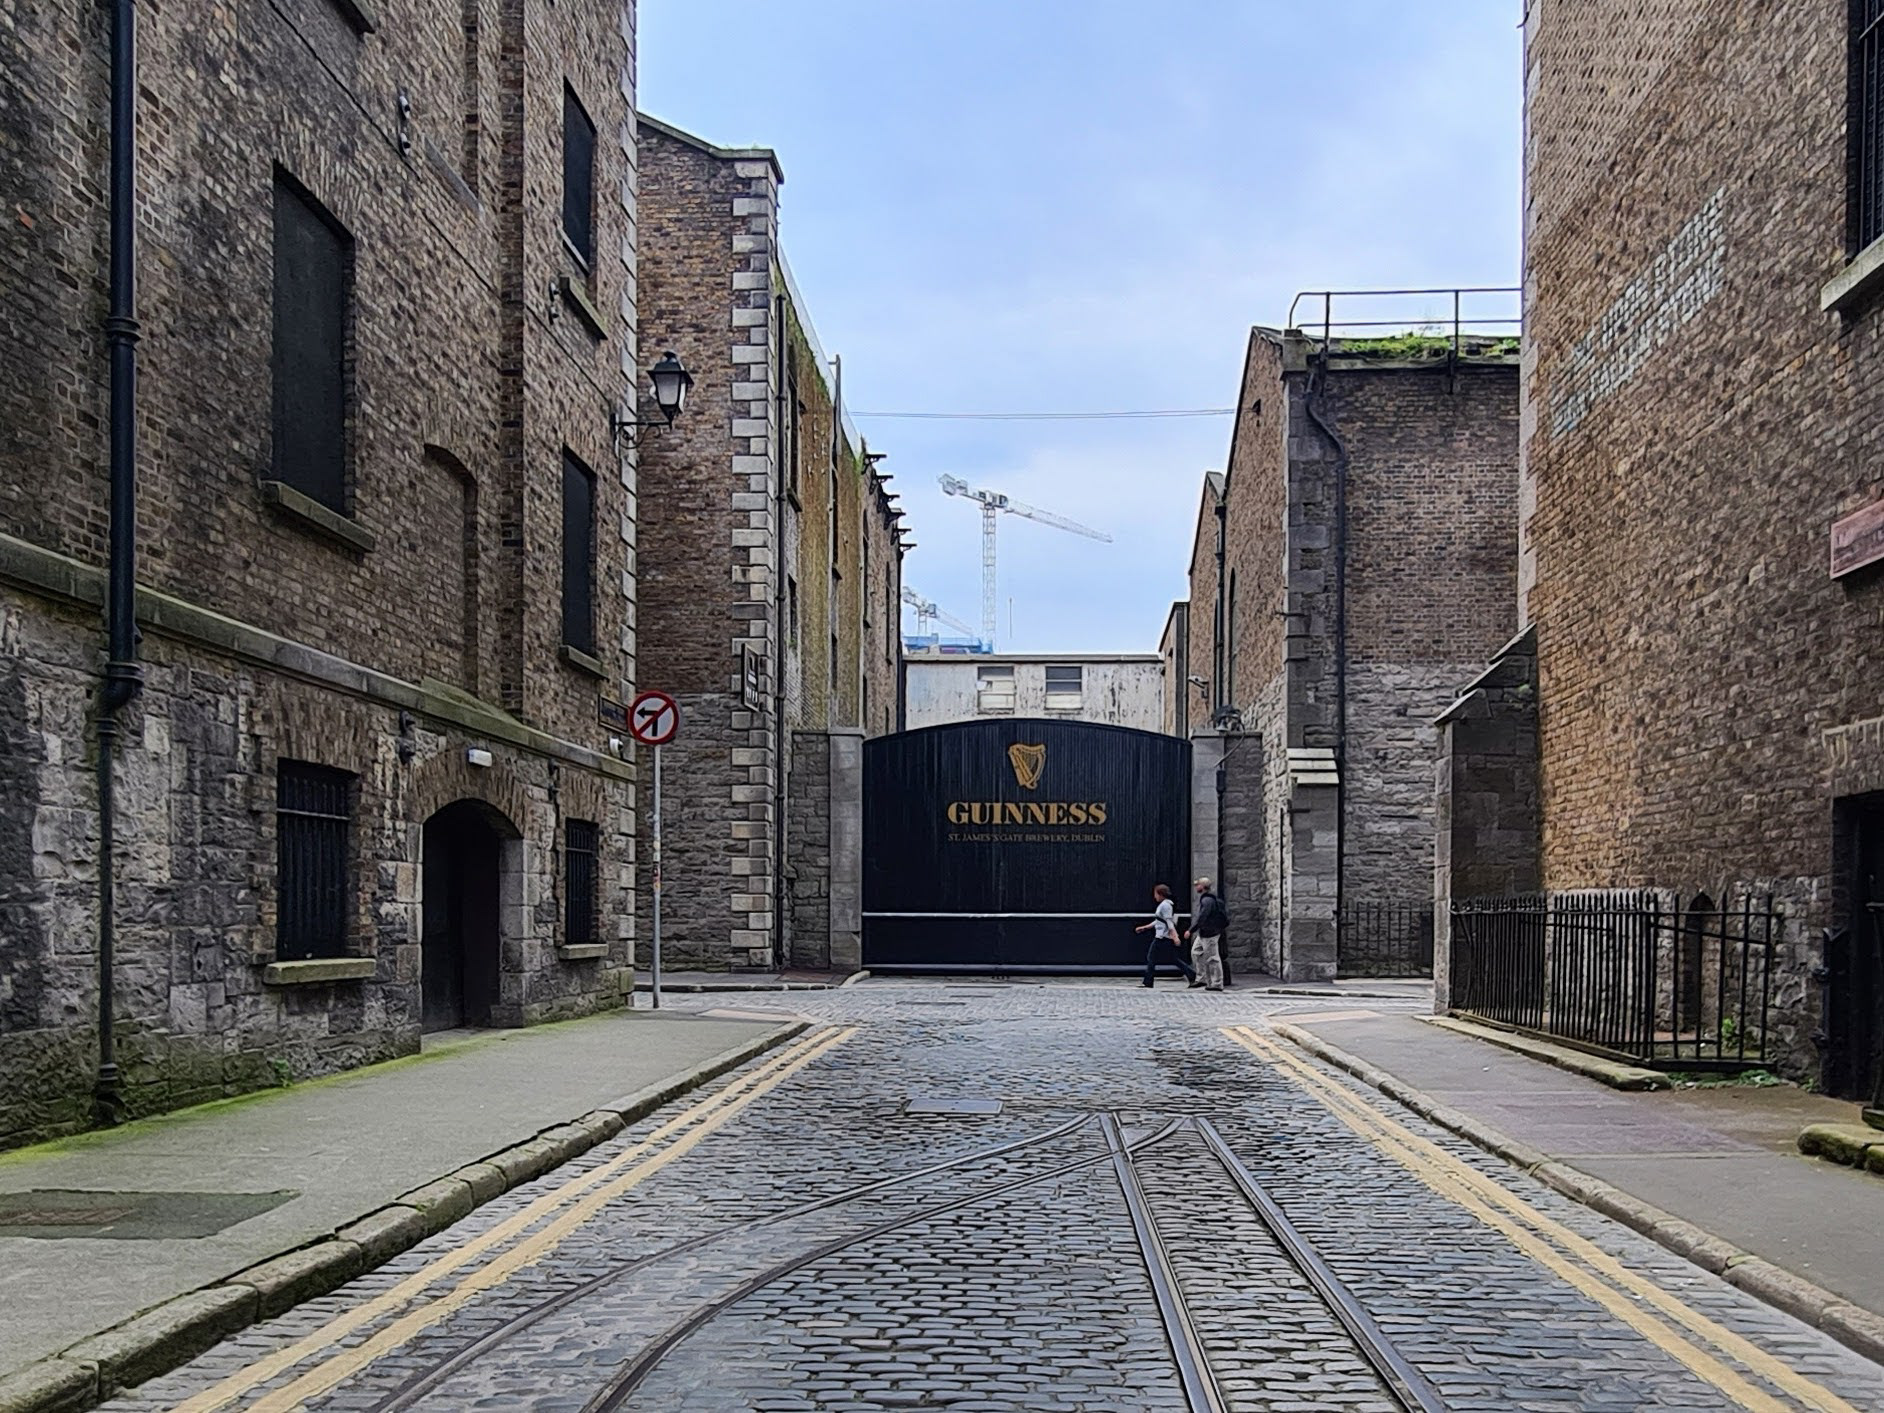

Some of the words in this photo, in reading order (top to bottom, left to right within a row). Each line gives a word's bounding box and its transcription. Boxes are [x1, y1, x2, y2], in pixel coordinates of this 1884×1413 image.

[947, 802, 1107, 825] GUINNESS
[948, 833, 960, 842] ST.
[1000, 833, 1024, 842] GATE
[1071, 833, 1105, 842] DUBLIN
